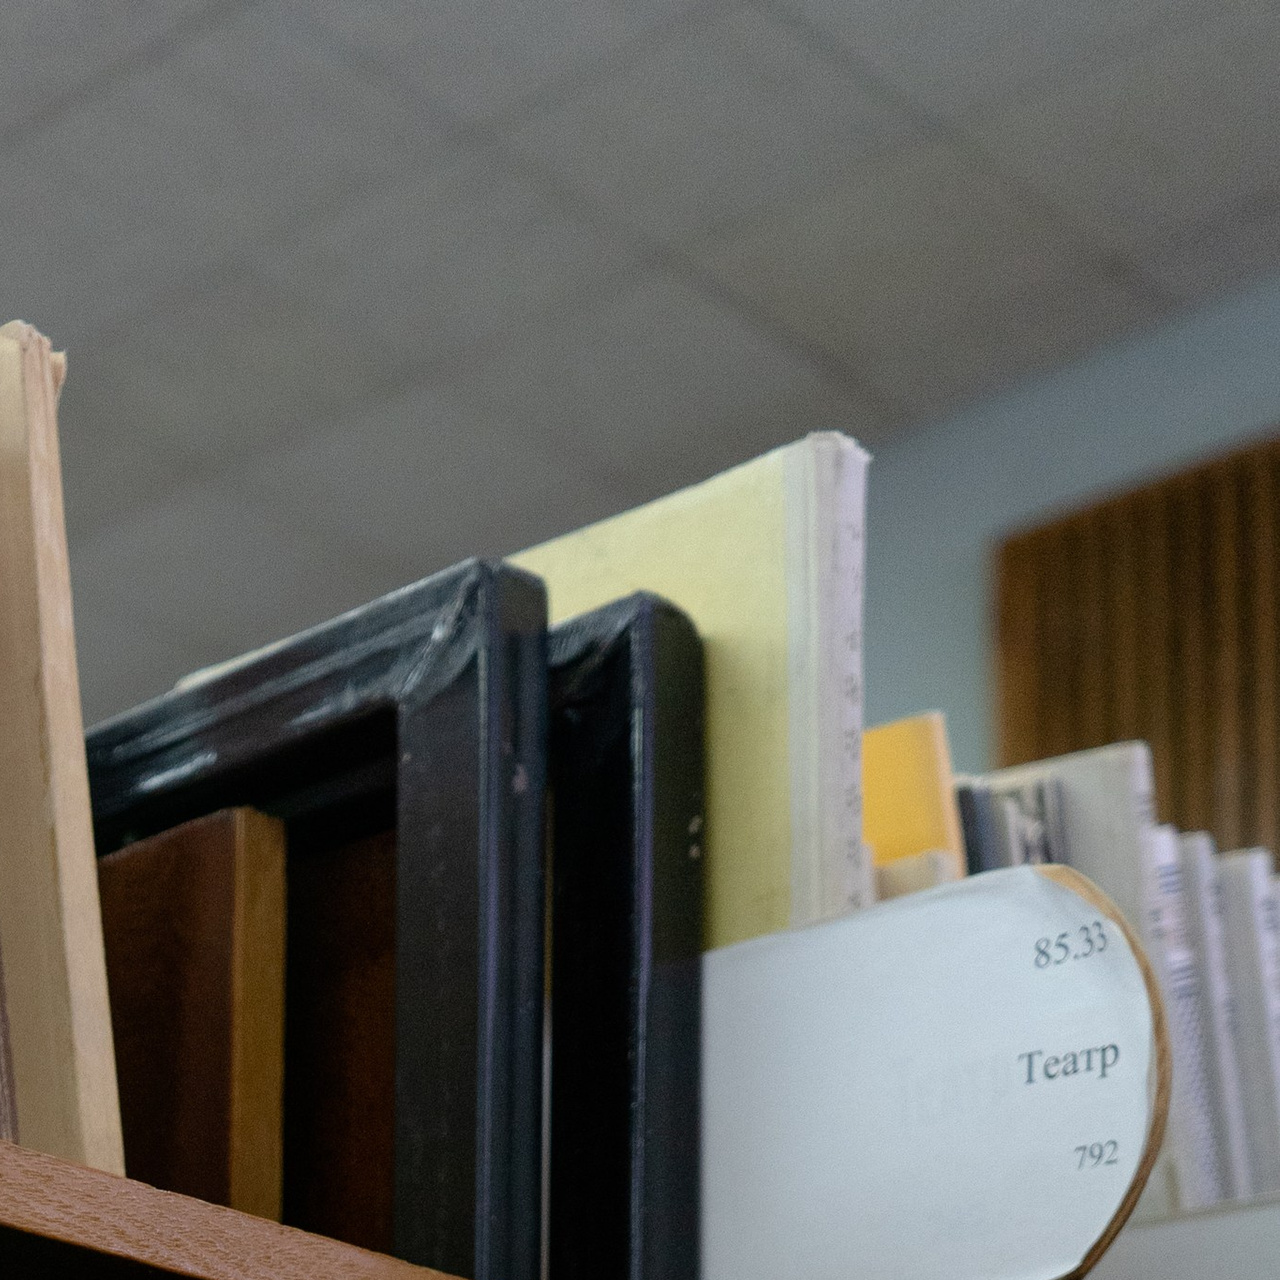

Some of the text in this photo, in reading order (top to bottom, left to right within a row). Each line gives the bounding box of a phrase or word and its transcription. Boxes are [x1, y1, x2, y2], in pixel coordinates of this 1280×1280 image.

[1034, 921, 1108, 969] 85.33
[1018, 1043, 1120, 1084] Театр
[1074, 1139, 1119, 1170] 792
